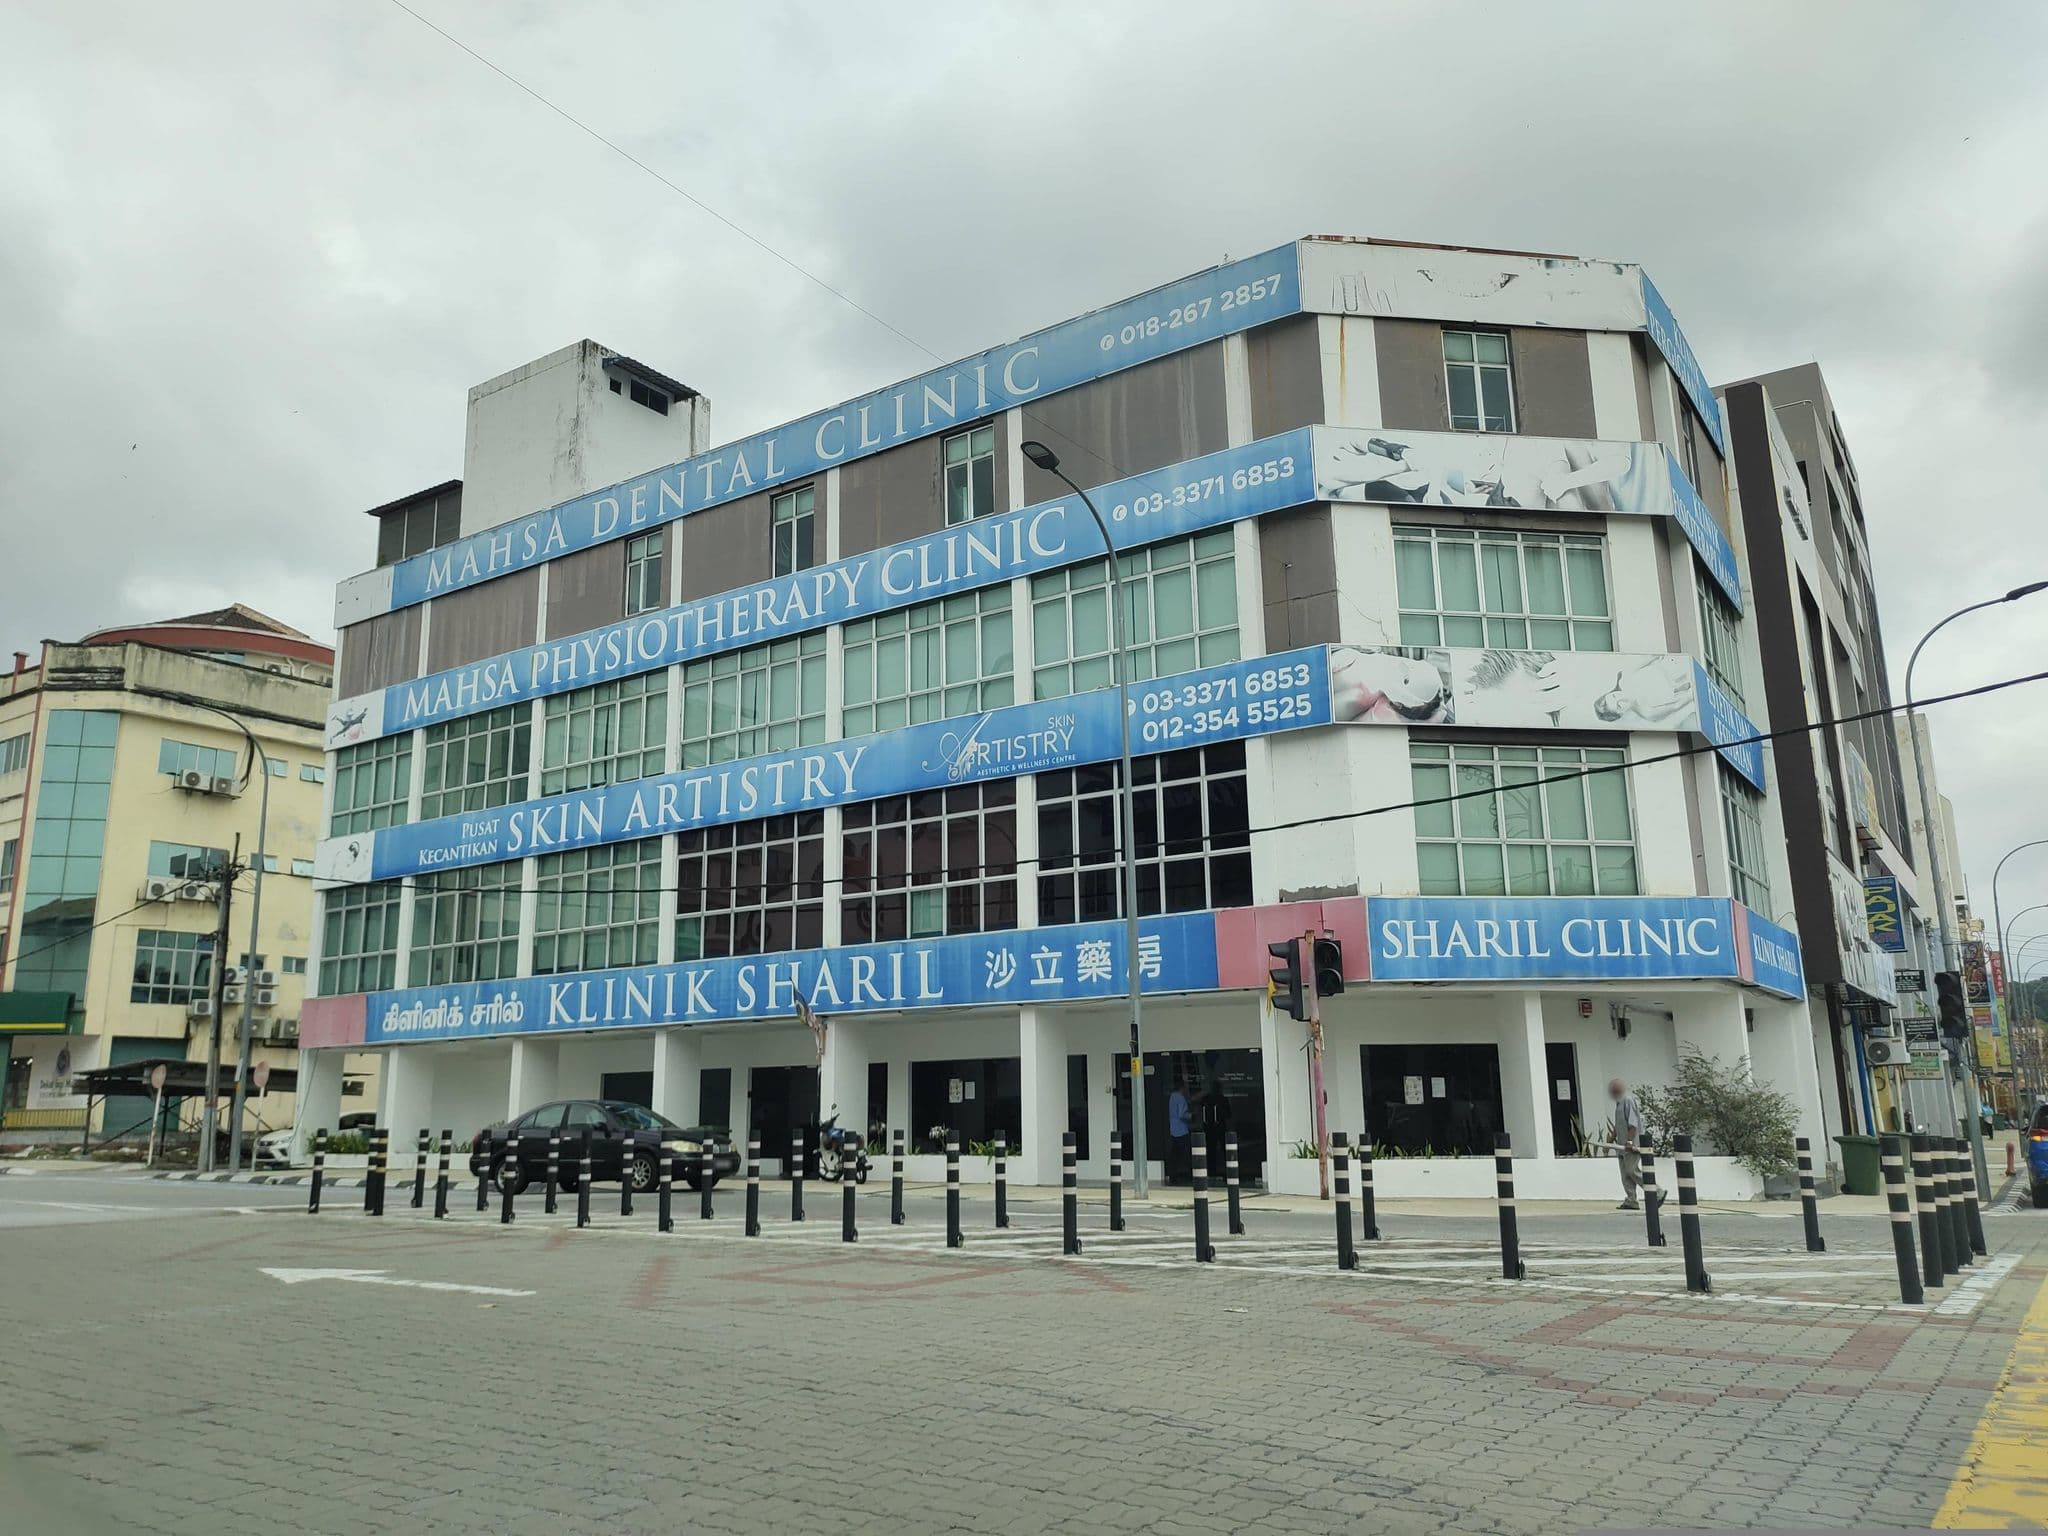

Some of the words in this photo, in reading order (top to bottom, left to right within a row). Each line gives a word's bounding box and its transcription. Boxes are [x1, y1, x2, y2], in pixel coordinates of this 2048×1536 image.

[1120, 297, 1213, 346] 018-267
[1218, 273, 1282, 312] 2857
[426, 520, 568, 594] MAHSA
[591, 439, 787, 539] DENTAL
[815, 346, 1041, 460] CLINIC
[1132, 475, 1226, 519] 03-3371
[1231, 456, 1296, 490] 6853
[402, 657, 520, 724] MAHSA
[529, 561, 868, 692] PHYSIOTHERAPY
[880, 506, 1067, 595] CLINIC
[1142, 677, 1237, 714] 03-3371
[1244, 663, 1311, 695] 6853
[1048, 713, 1075, 729] SKIN
[1142, 706, 1239, 742] 012-354
[1247, 693, 1312, 724] 5525
[977, 765, 1010, 776] AESTHETIC
[1017, 759, 1050, 770] WELLNESS
[1051, 754, 1077, 763] CENTRE
[506, 797, 606, 853] SKIN
[621, 746, 868, 833] ARTISTRY
[418, 839, 498, 865] KECANTIKAN
[462, 819, 500, 838] PUSAT
[1381, 919, 1551, 959] SHARIL
[1561, 918, 1721, 957] CLINIC
[547, 969, 718, 1025] KLINIK
[736, 949, 945, 1012] SHARIL
